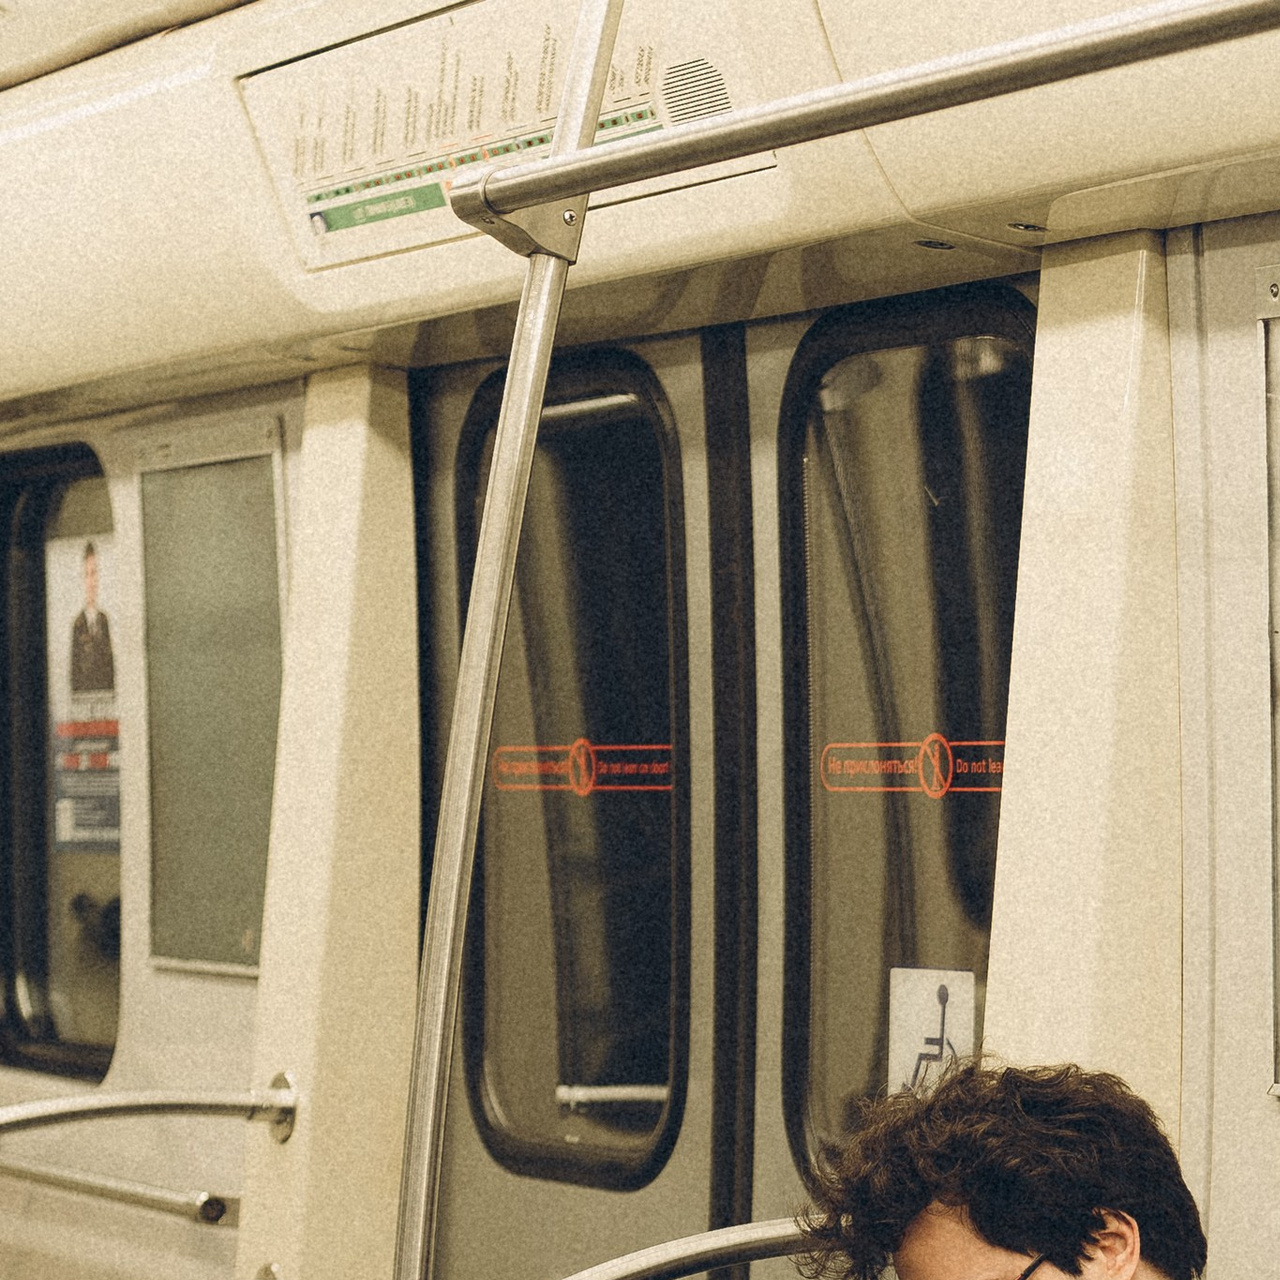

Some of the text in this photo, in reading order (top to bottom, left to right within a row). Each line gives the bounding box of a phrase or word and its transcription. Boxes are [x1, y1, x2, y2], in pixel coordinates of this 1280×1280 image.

[955, 758, 1005, 774] Do not lea
